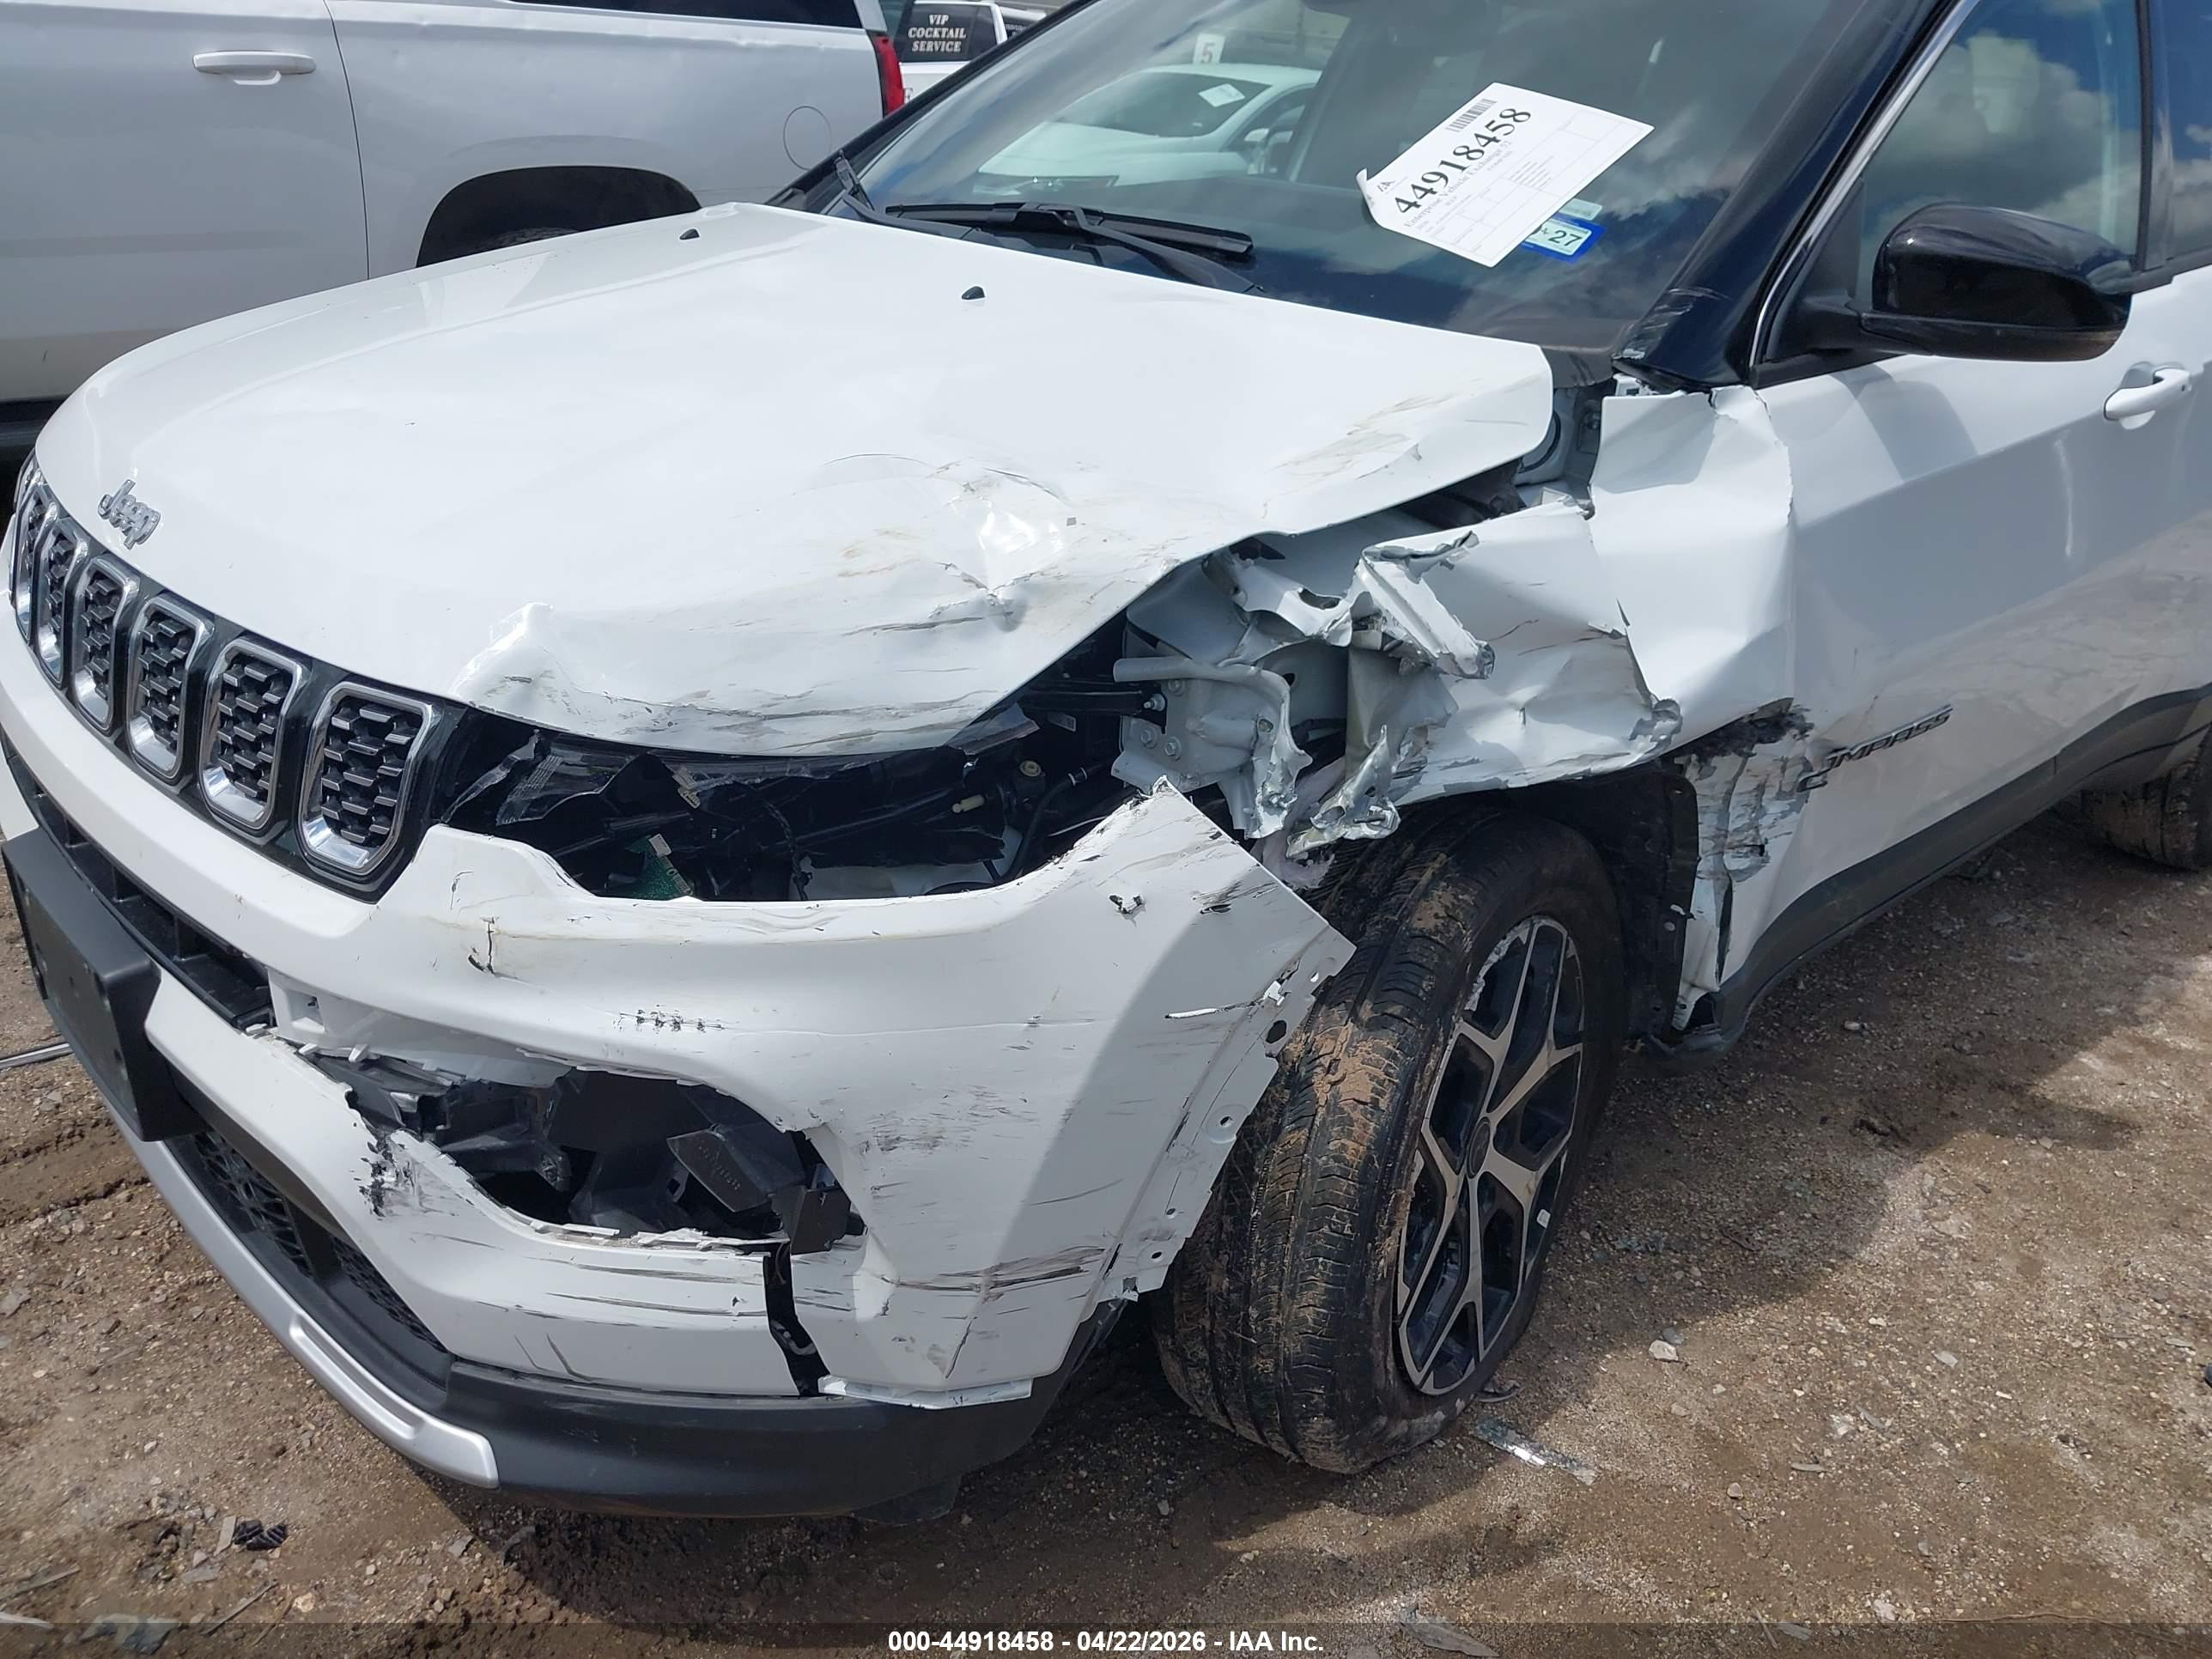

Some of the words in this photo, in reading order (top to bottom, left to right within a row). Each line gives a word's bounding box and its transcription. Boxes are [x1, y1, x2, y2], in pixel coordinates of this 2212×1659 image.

[929, 14, 949, 26] VIP
[908, 27, 966, 39] COCKTAIL
[912, 40, 962, 52] SERVICE
[1395, 107, 1532, 215] 44918458
[1548, 229, 1583, 246] 27
[97, 479, 161, 550] Jeep
